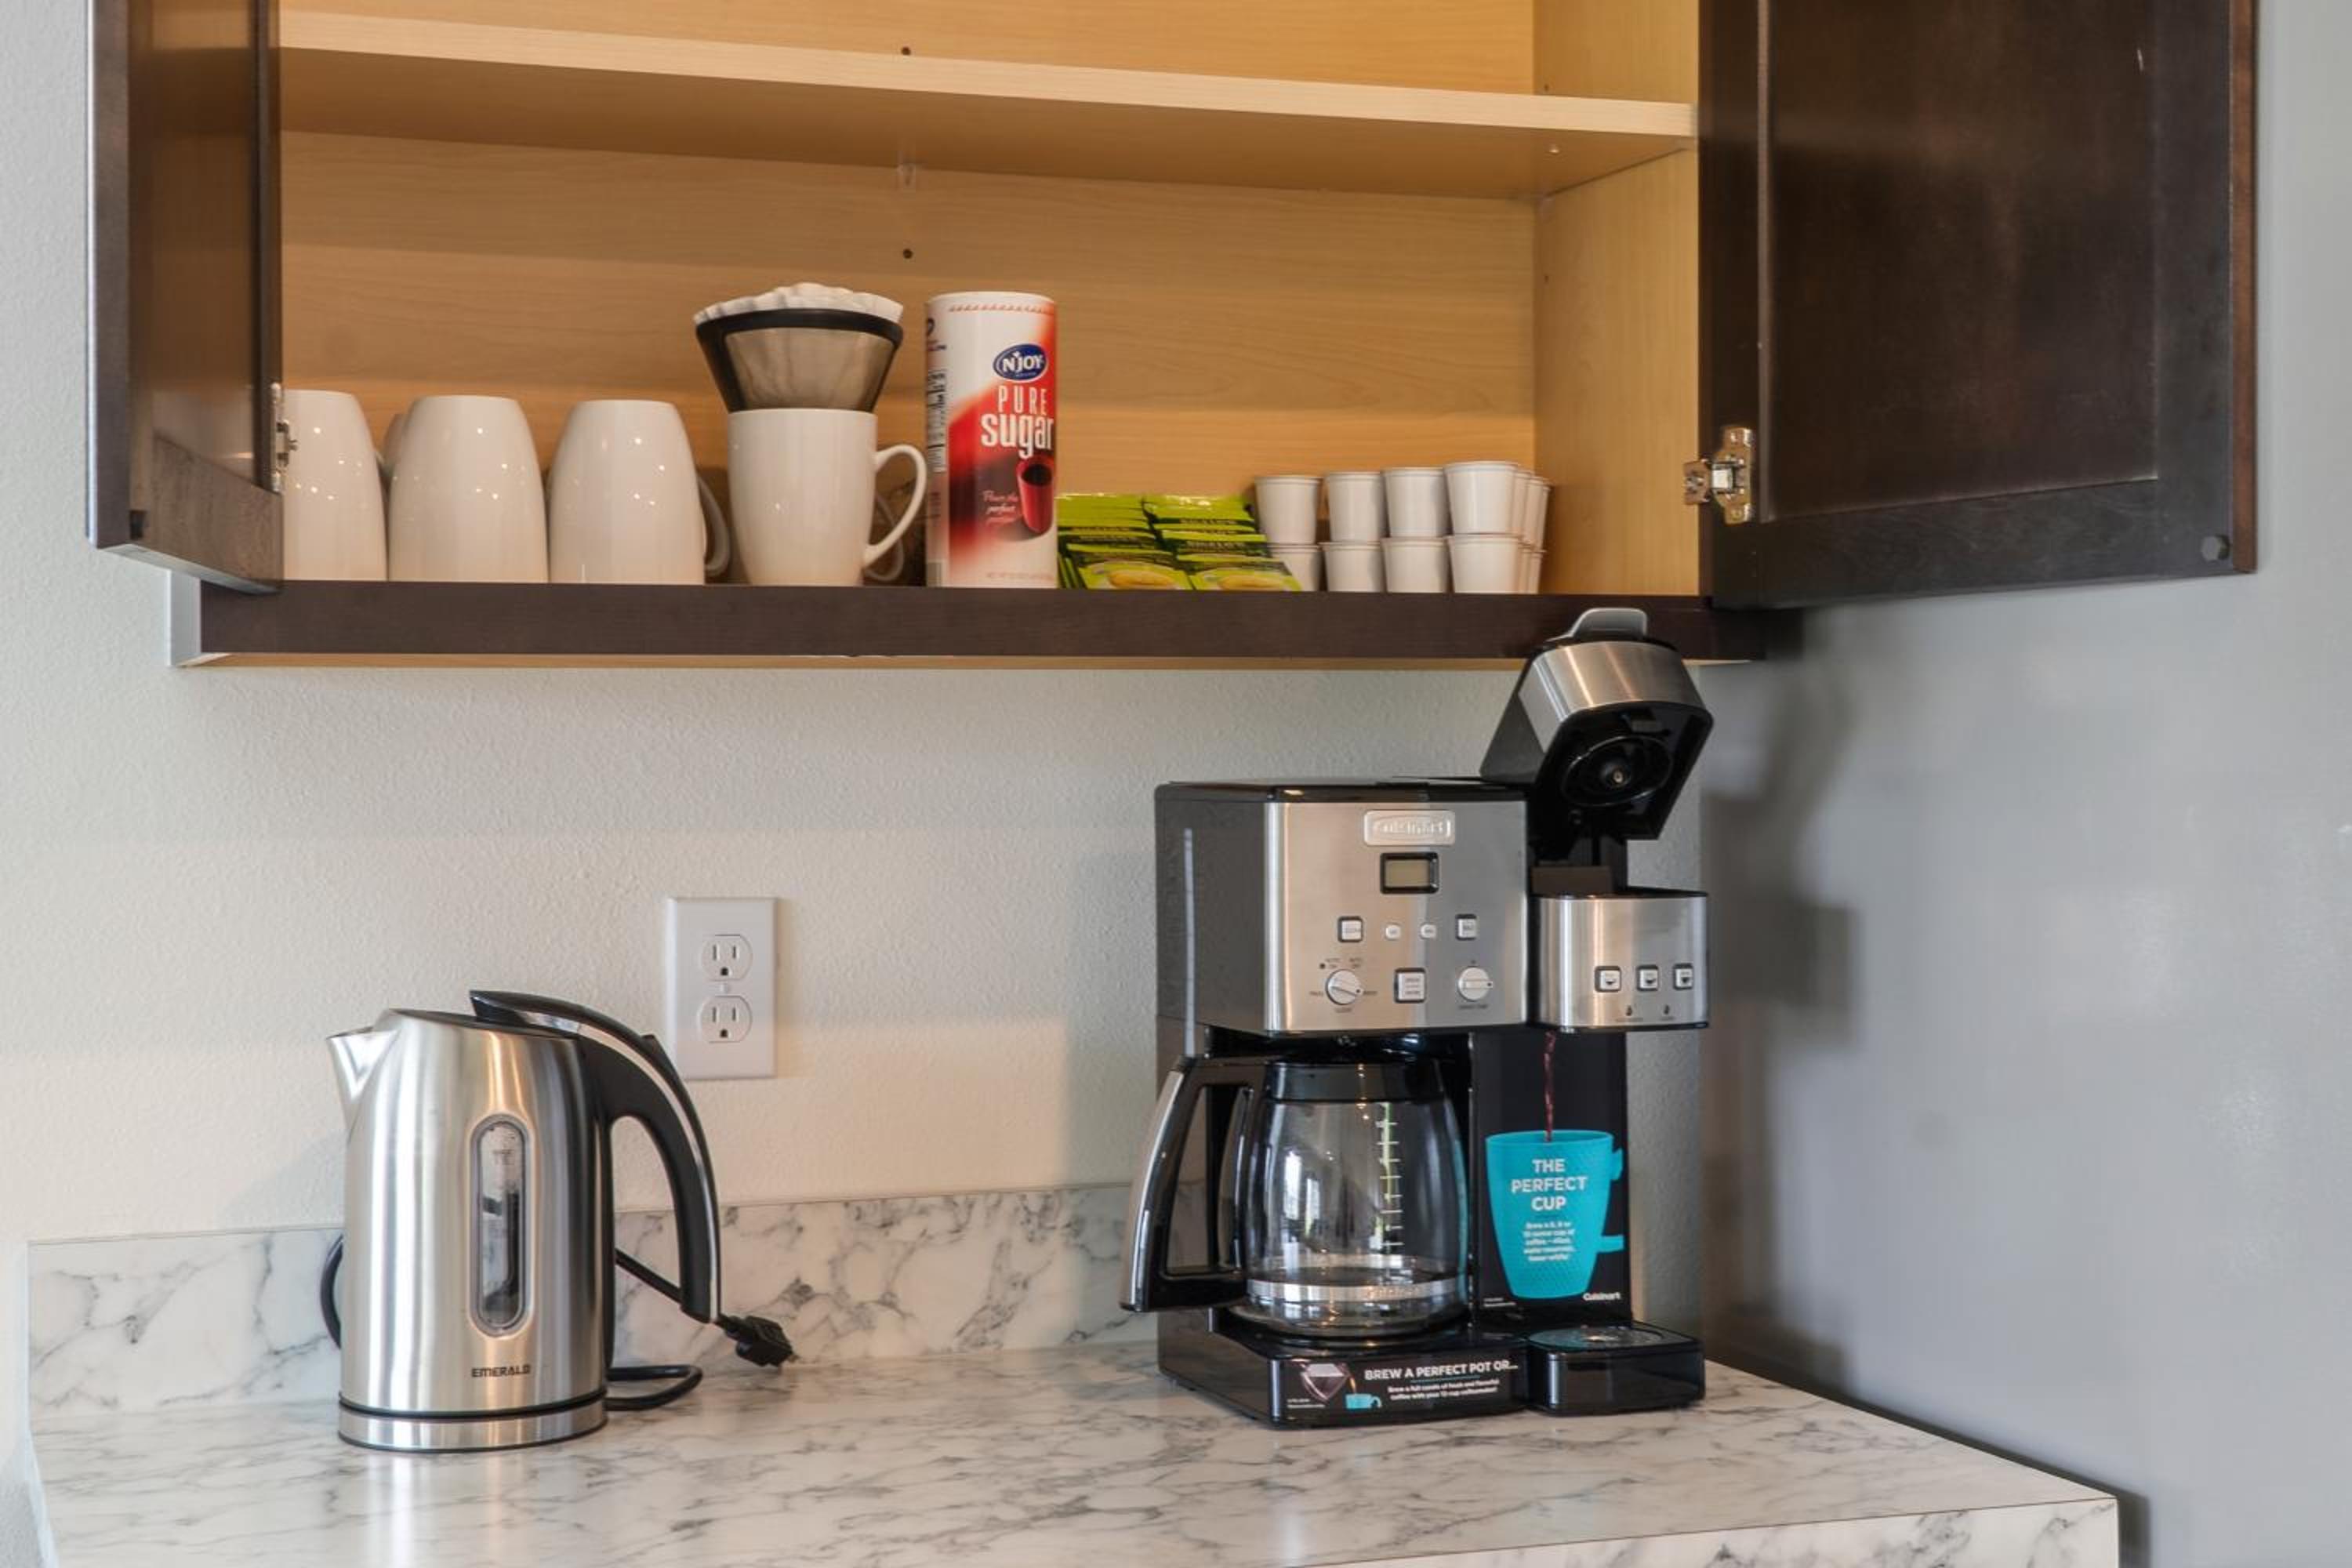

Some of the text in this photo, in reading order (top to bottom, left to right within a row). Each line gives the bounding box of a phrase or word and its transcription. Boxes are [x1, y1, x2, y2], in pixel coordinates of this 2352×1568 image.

[998, 385, 1047, 416] PURE
[980, 413, 1054, 460] sugar
[1531, 1158, 1566, 1174] THE
[1511, 1176, 1588, 1195] PERFECT
[1531, 1196, 1566, 1211] CUP
[471, 1364, 531, 1378] EMERALD
[1364, 1367, 1403, 1381] BREW
[1404, 1367, 1414, 1378] A
[1415, 1363, 1466, 1378] PERFECT
[1468, 1362, 1492, 1374] POT
